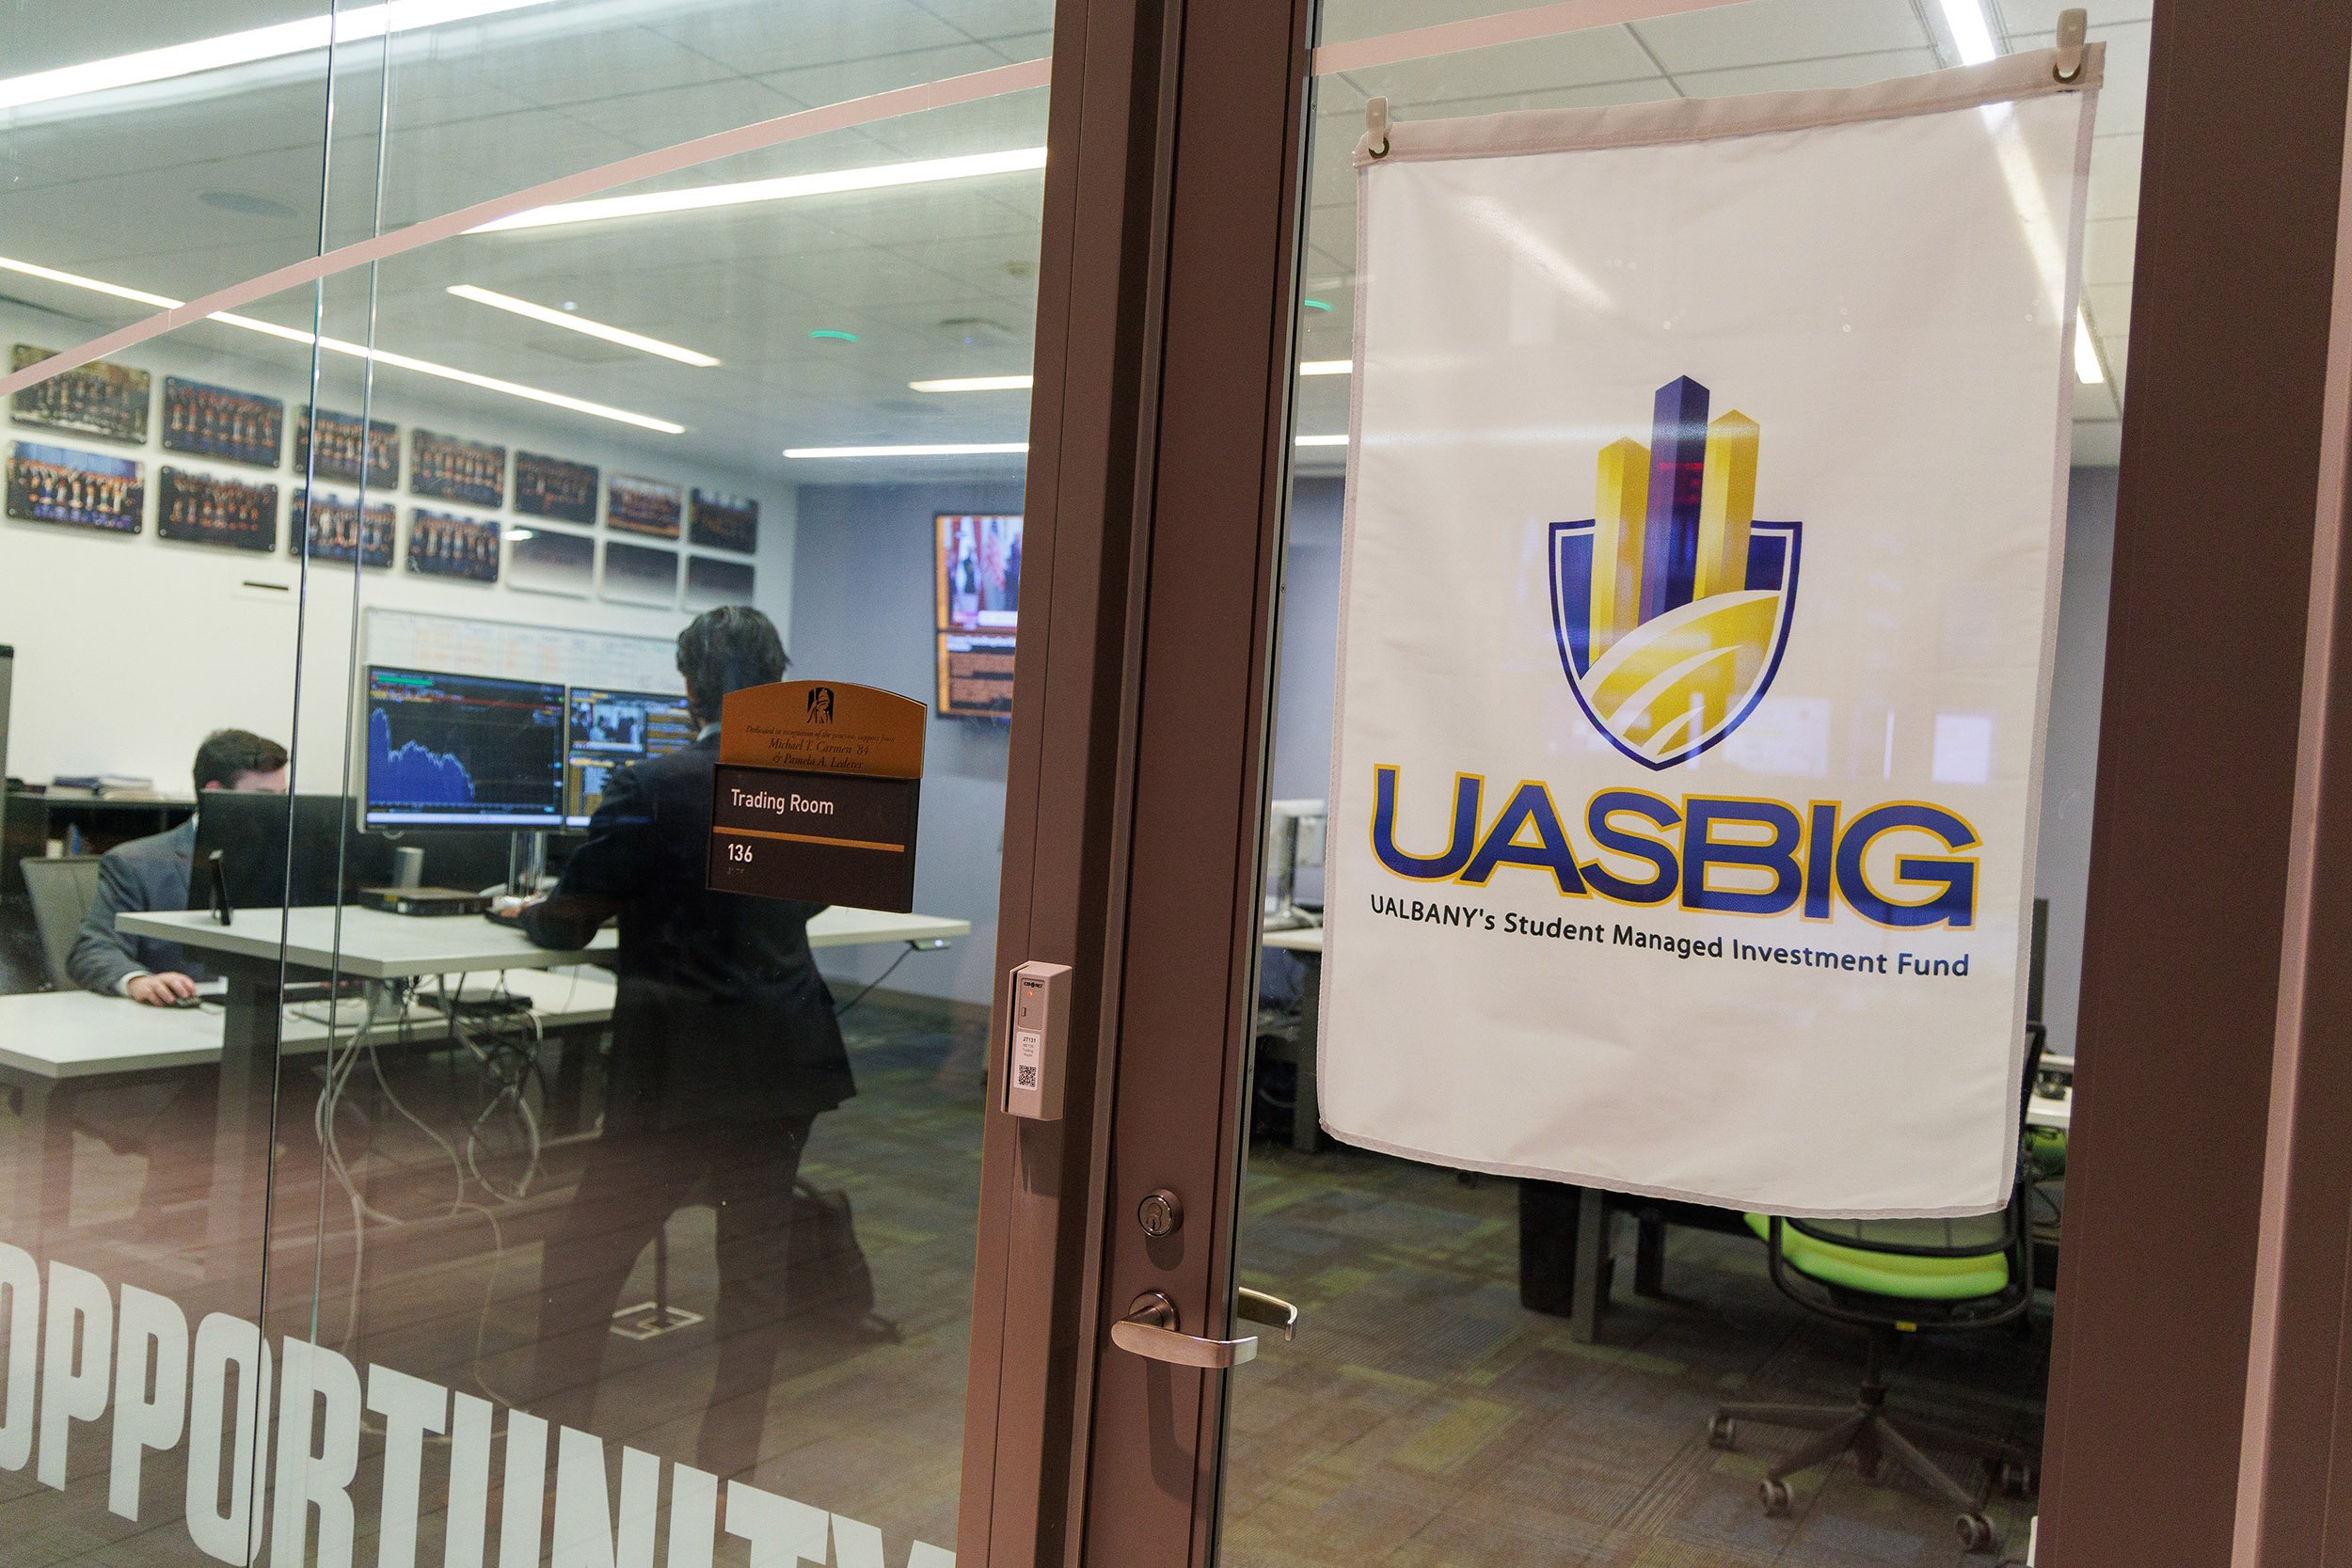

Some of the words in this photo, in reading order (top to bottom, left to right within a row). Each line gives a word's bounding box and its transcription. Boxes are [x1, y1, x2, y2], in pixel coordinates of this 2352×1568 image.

[769, 737, 804, 751] Michael
[817, 740, 851, 753] Carmen
[784, 753, 815, 766] Pamela
[731, 788, 785, 815] Trading
[790, 794, 834, 815] Room
[727, 844, 753, 863] 136
[1370, 763, 1983, 931] UASBIG
[1371, 894, 1495, 930] UALBANY's
[1504, 912, 1604, 943] Student
[1613, 925, 1724, 959] Managed
[1733, 939, 1887, 974] Investment
[1898, 953, 1970, 977] Fund
